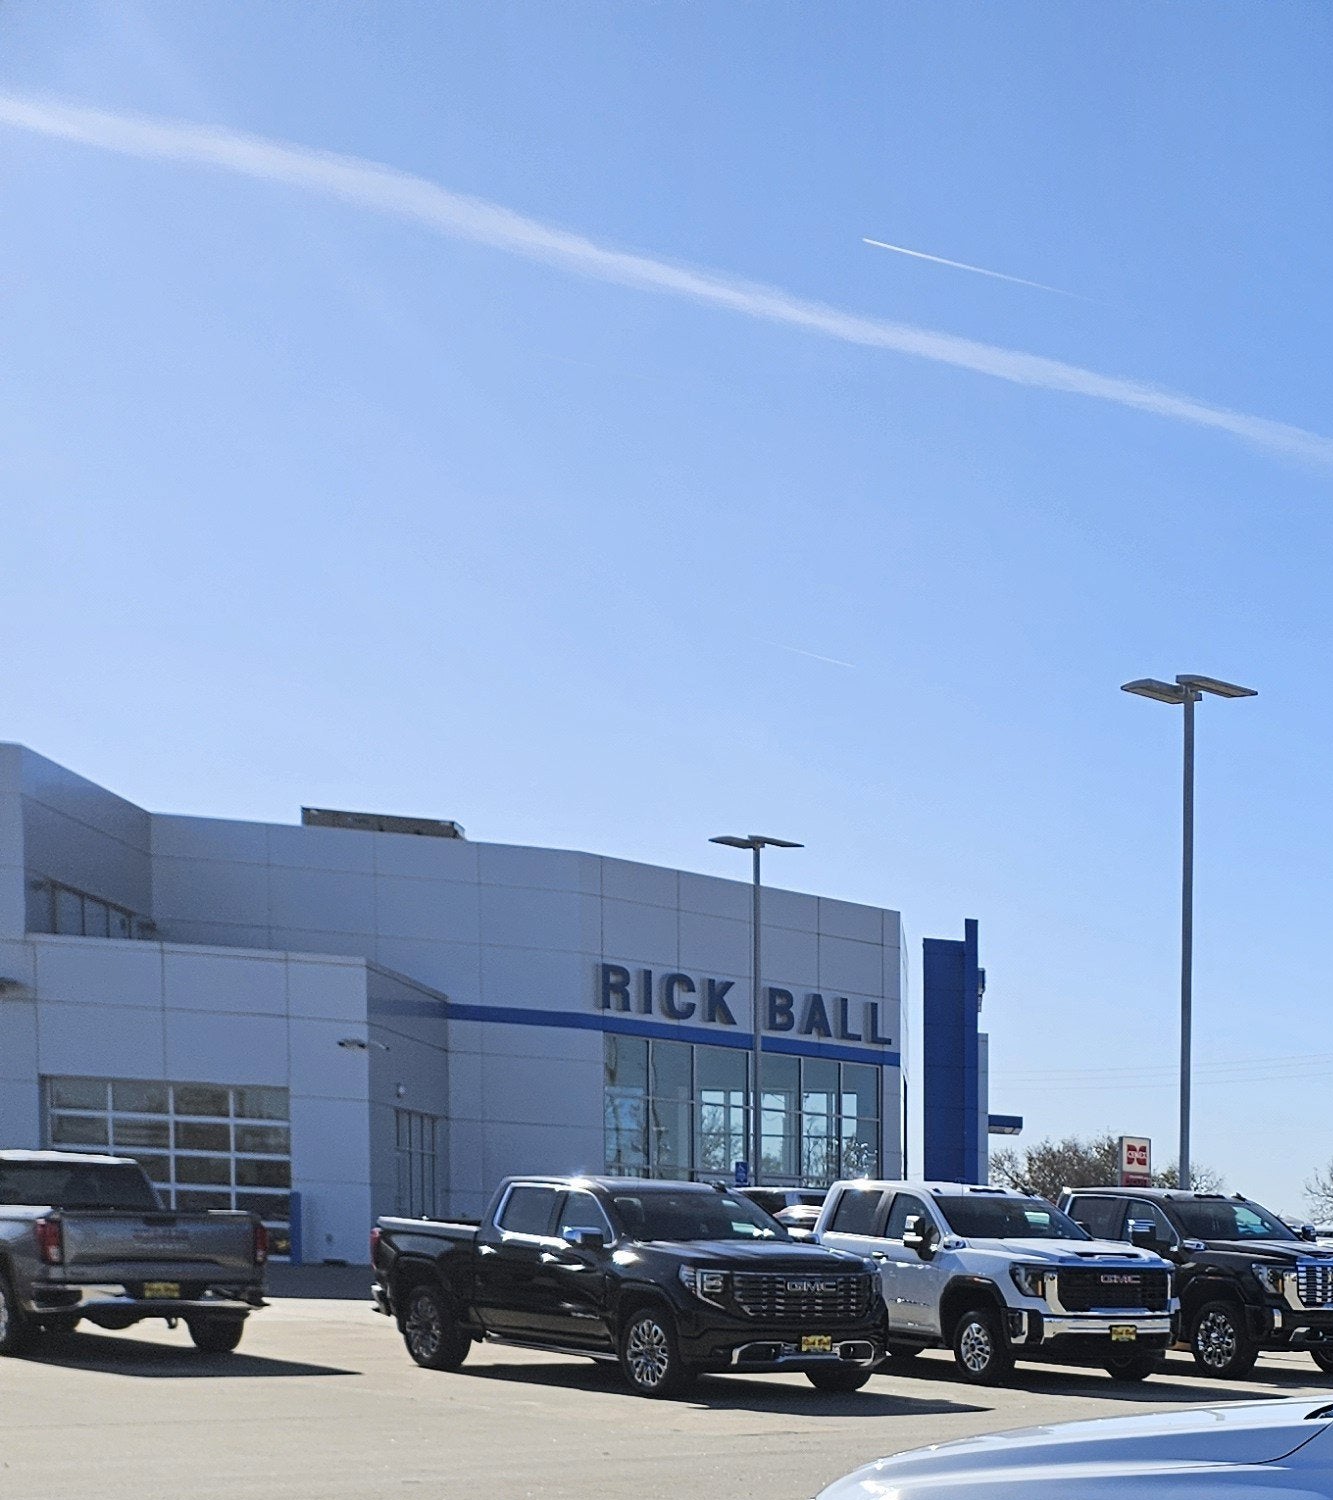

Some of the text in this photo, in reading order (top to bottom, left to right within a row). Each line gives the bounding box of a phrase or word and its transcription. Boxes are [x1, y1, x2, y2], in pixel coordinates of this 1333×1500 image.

[595, 962, 893, 1045] RICK BALL
[1100, 1274, 1141, 1283] GMC
[787, 1281, 837, 1291] GMC
